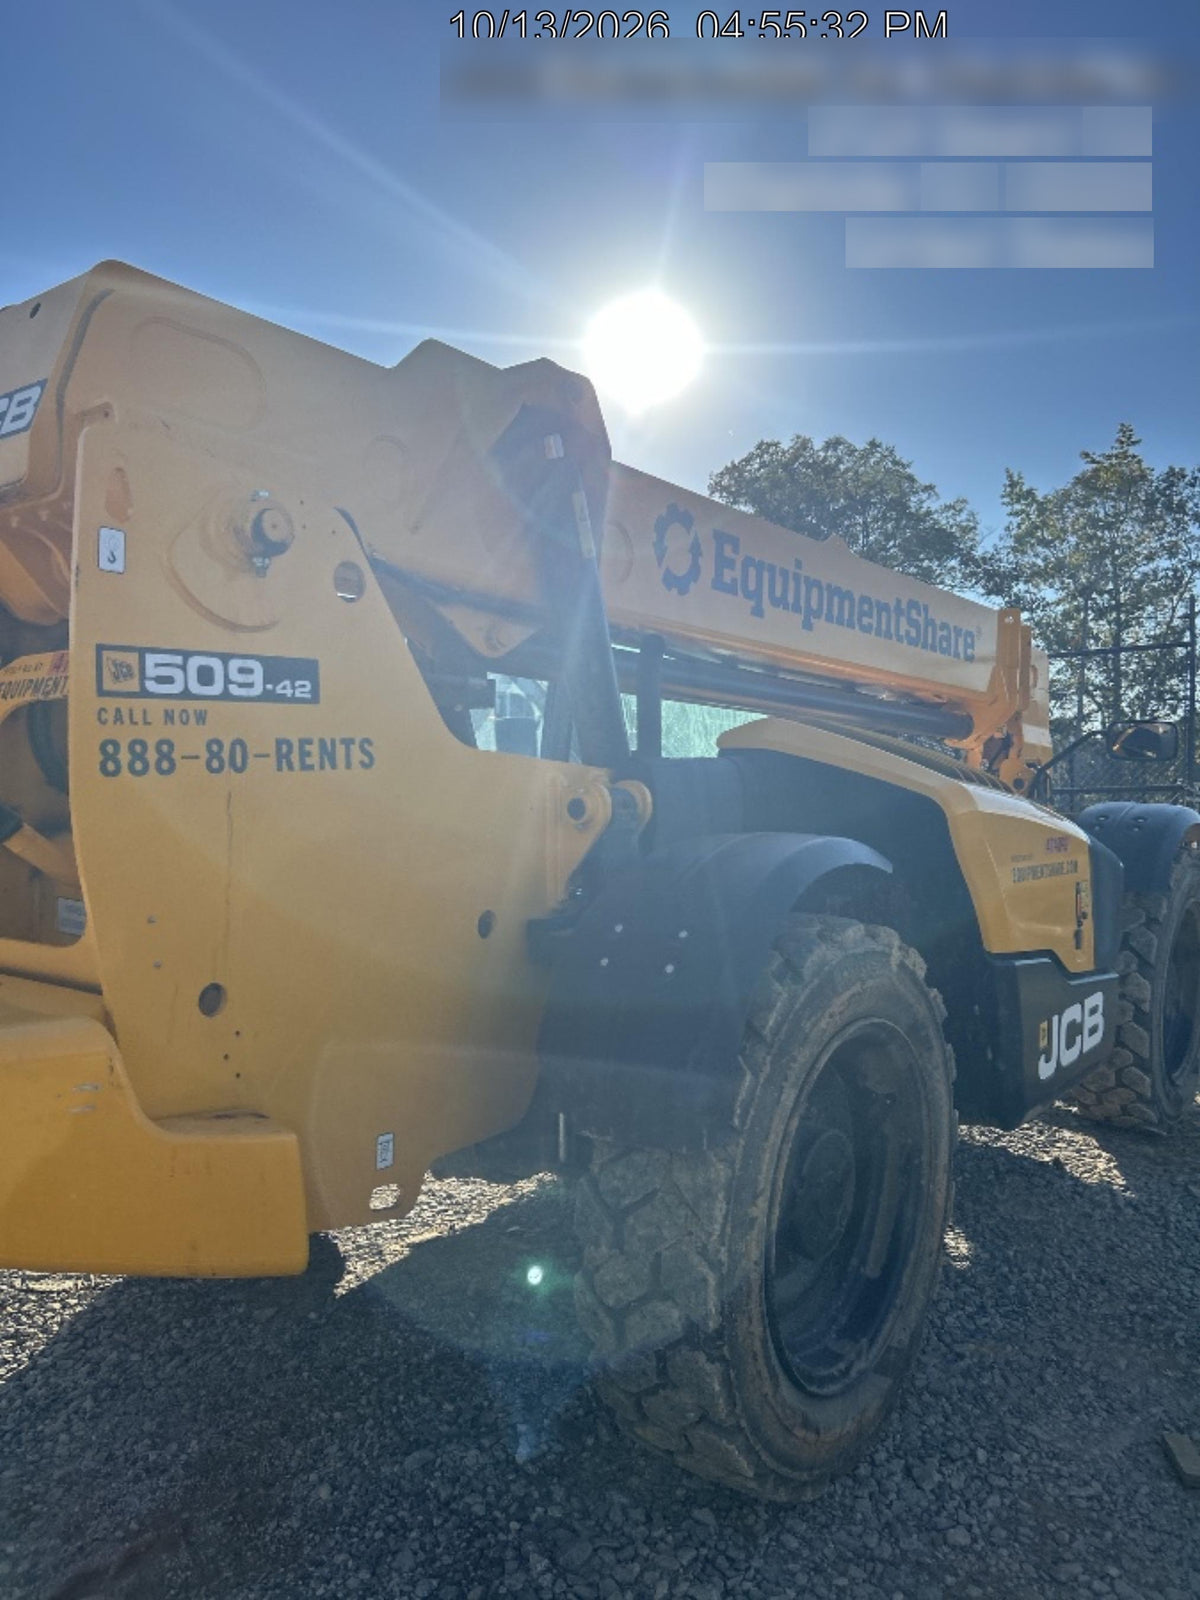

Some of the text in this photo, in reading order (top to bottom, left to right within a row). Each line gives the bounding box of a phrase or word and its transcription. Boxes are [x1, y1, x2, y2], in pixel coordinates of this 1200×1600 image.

[710, 528, 976, 663] EquipmentShare
[97, 706, 208, 726] CALL NOW
[98, 737, 376, 778] 888-80-RENTS
[1037, 991, 1105, 1081] JCB
